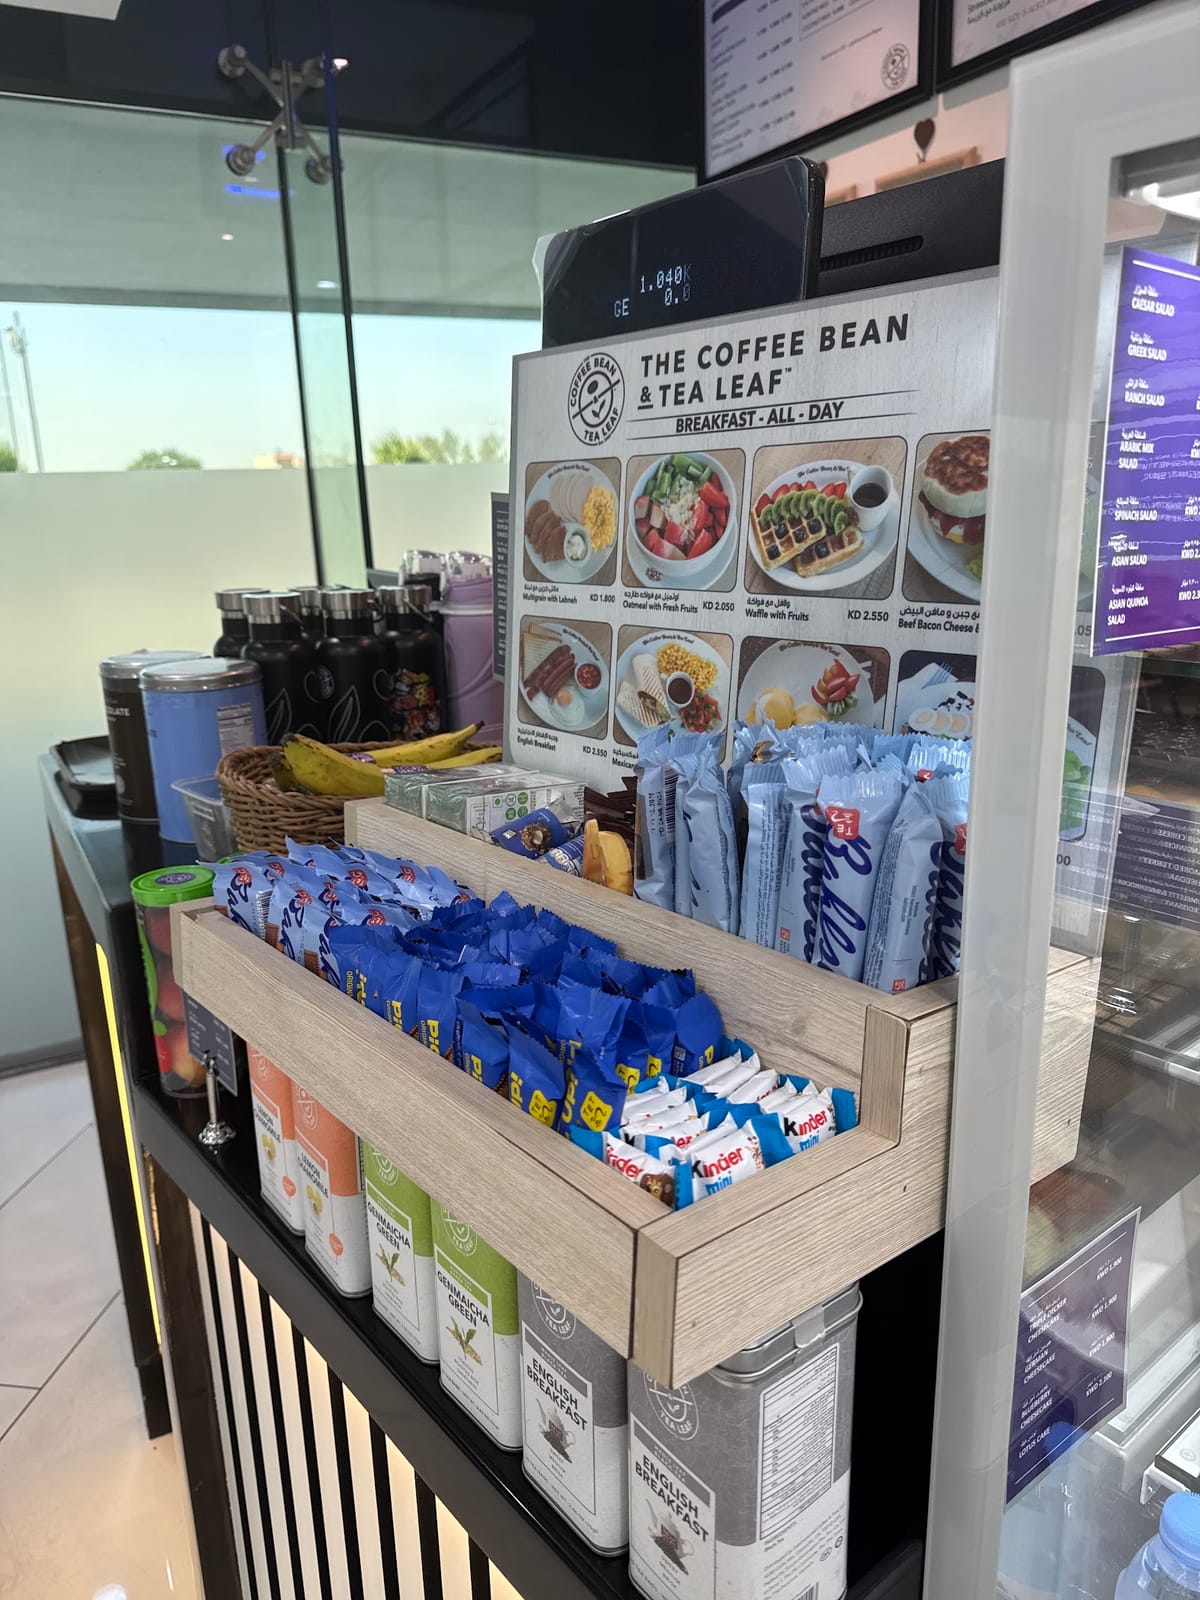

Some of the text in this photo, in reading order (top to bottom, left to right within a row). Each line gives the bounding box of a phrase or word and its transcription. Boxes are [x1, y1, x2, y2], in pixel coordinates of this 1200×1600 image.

[1131, 297, 1175, 317] CAESAR SALAD
[641, 313, 909, 378] THE COFFEE BEAN
[1127, 344, 1167, 361] GREEK SALAD
[570, 357, 617, 407] COFFEE BEAN
[637, 386, 654, 410] &
[659, 380, 704, 407] TEA
[1124, 391, 1165, 407] RANCH SALAD
[584, 407, 619, 442] TEA LEAF
[676, 410, 756, 434] BREAKFAST
[767, 407, 795, 425] ALL
[808, 401, 845, 421] DAY
[1120, 441, 1154, 454] ARABIC MIX
[1118, 457, 1138, 470] SALAD
[1114, 509, 1139, 521] SPINACH
[1140, 509, 1158, 521] SALAD
[1111, 554, 1148, 567] ASIAN SALAD
[590, 594, 616, 603] KD 1.800
[623, 600, 698, 613] Oatmeal with Fresh Fruits
[702, 601, 735, 612] KD 2.050
[1108, 599, 1126, 610] ASIAN
[745, 608, 809, 621] Waffle with Fruits
[848, 610, 889, 621] KD 2.550
[898, 618, 917, 629] Beef
[917, 619, 941, 631] Bacon
[943, 621, 973, 633] Cheese
[1107, 614, 1126, 626] SALAD
[517, 736, 556, 751] English Breakfast
[582, 746, 607, 758] KD 2.550
[300, 1151, 321, 1180] LEMON
[367, 1201, 411, 1249] GENMAICHA
[376, 1221, 400, 1251] GREEN
[437, 1270, 490, 1327] GENMAICHA
[448, 1293, 478, 1328] GREEN
[545, 1316, 571, 1334] TEA LEAF
[1023, 1352, 1056, 1384] CHEESECAKE
[1024, 1349, 1049, 1373] GERMAN
[532, 1358, 578, 1411] ENGLISH
[526, 1365, 588, 1431] BREAKFAST
[1021, 1388, 1051, 1419] BLUEBERRY
[660, 1411, 693, 1435] TEA LEAF
[1020, 1397, 1053, 1430] CHEESECAKE
[1019, 1426, 1051, 1459] LOTUS CAKE
[642, 1454, 699, 1518] ENGLISH
[635, 1461, 709, 1542] BREAKFAST
